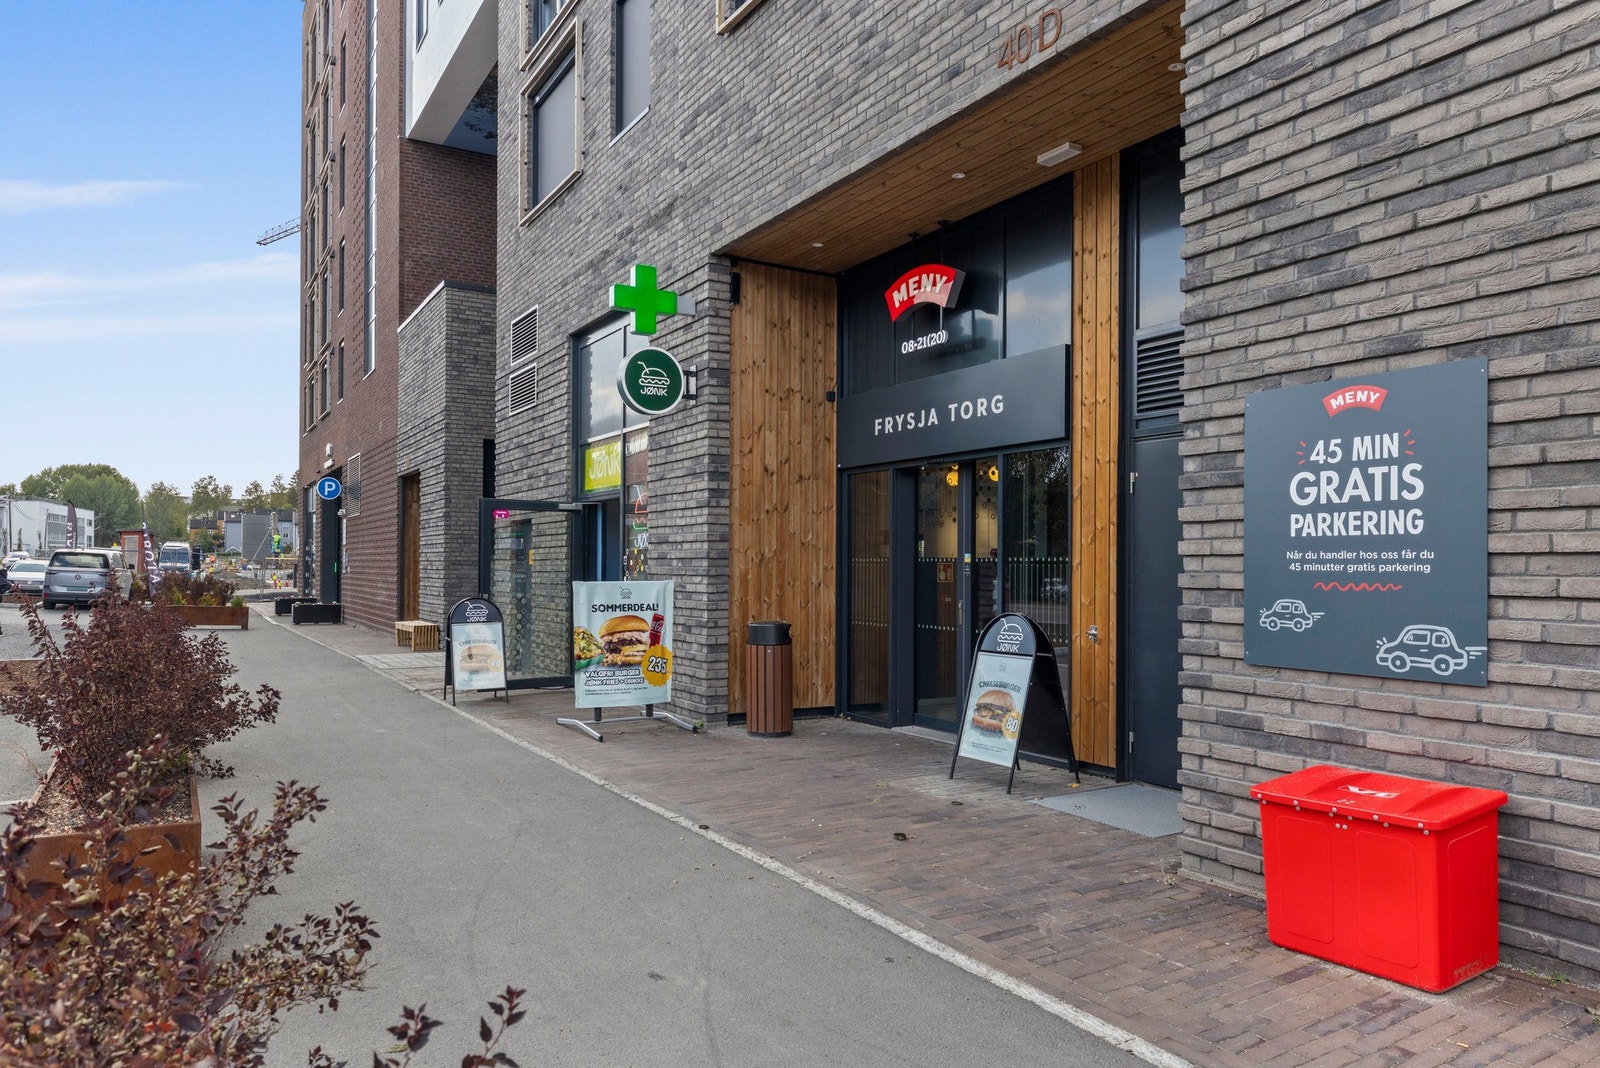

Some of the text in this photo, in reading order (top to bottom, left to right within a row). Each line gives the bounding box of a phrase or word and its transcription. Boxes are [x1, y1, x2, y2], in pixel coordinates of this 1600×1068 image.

[997, 7, 1062, 70] 40 D
[892, 272, 948, 309] MENY
[901, 330, 947, 354] 08-21(20)
[640, 386, 668, 397] JØNK
[1330, 390, 1380, 410] MENY
[874, 394, 1005, 436] FRYSJA TORG
[1309, 432, 1399, 465] 45 MIN
[324, 481, 336, 496] P
[1289, 462, 1425, 506] GRATIS
[1290, 508, 1424, 537] PARKERING
[1286, 548, 1434, 559] Når du handler hos oss får du
[1289, 562, 1431, 574] 45 minutter gratis parkering
[591, 603, 659, 613] SOMMERDEAL!
[996, 643, 1020, 653] JØNK
[584, 669, 641, 678] VALGFRI BURGER
[648, 656, 668, 674] 235
[979, 680, 1022, 693] CHEESEBURGER
[1005, 716, 1019, 733] 80
